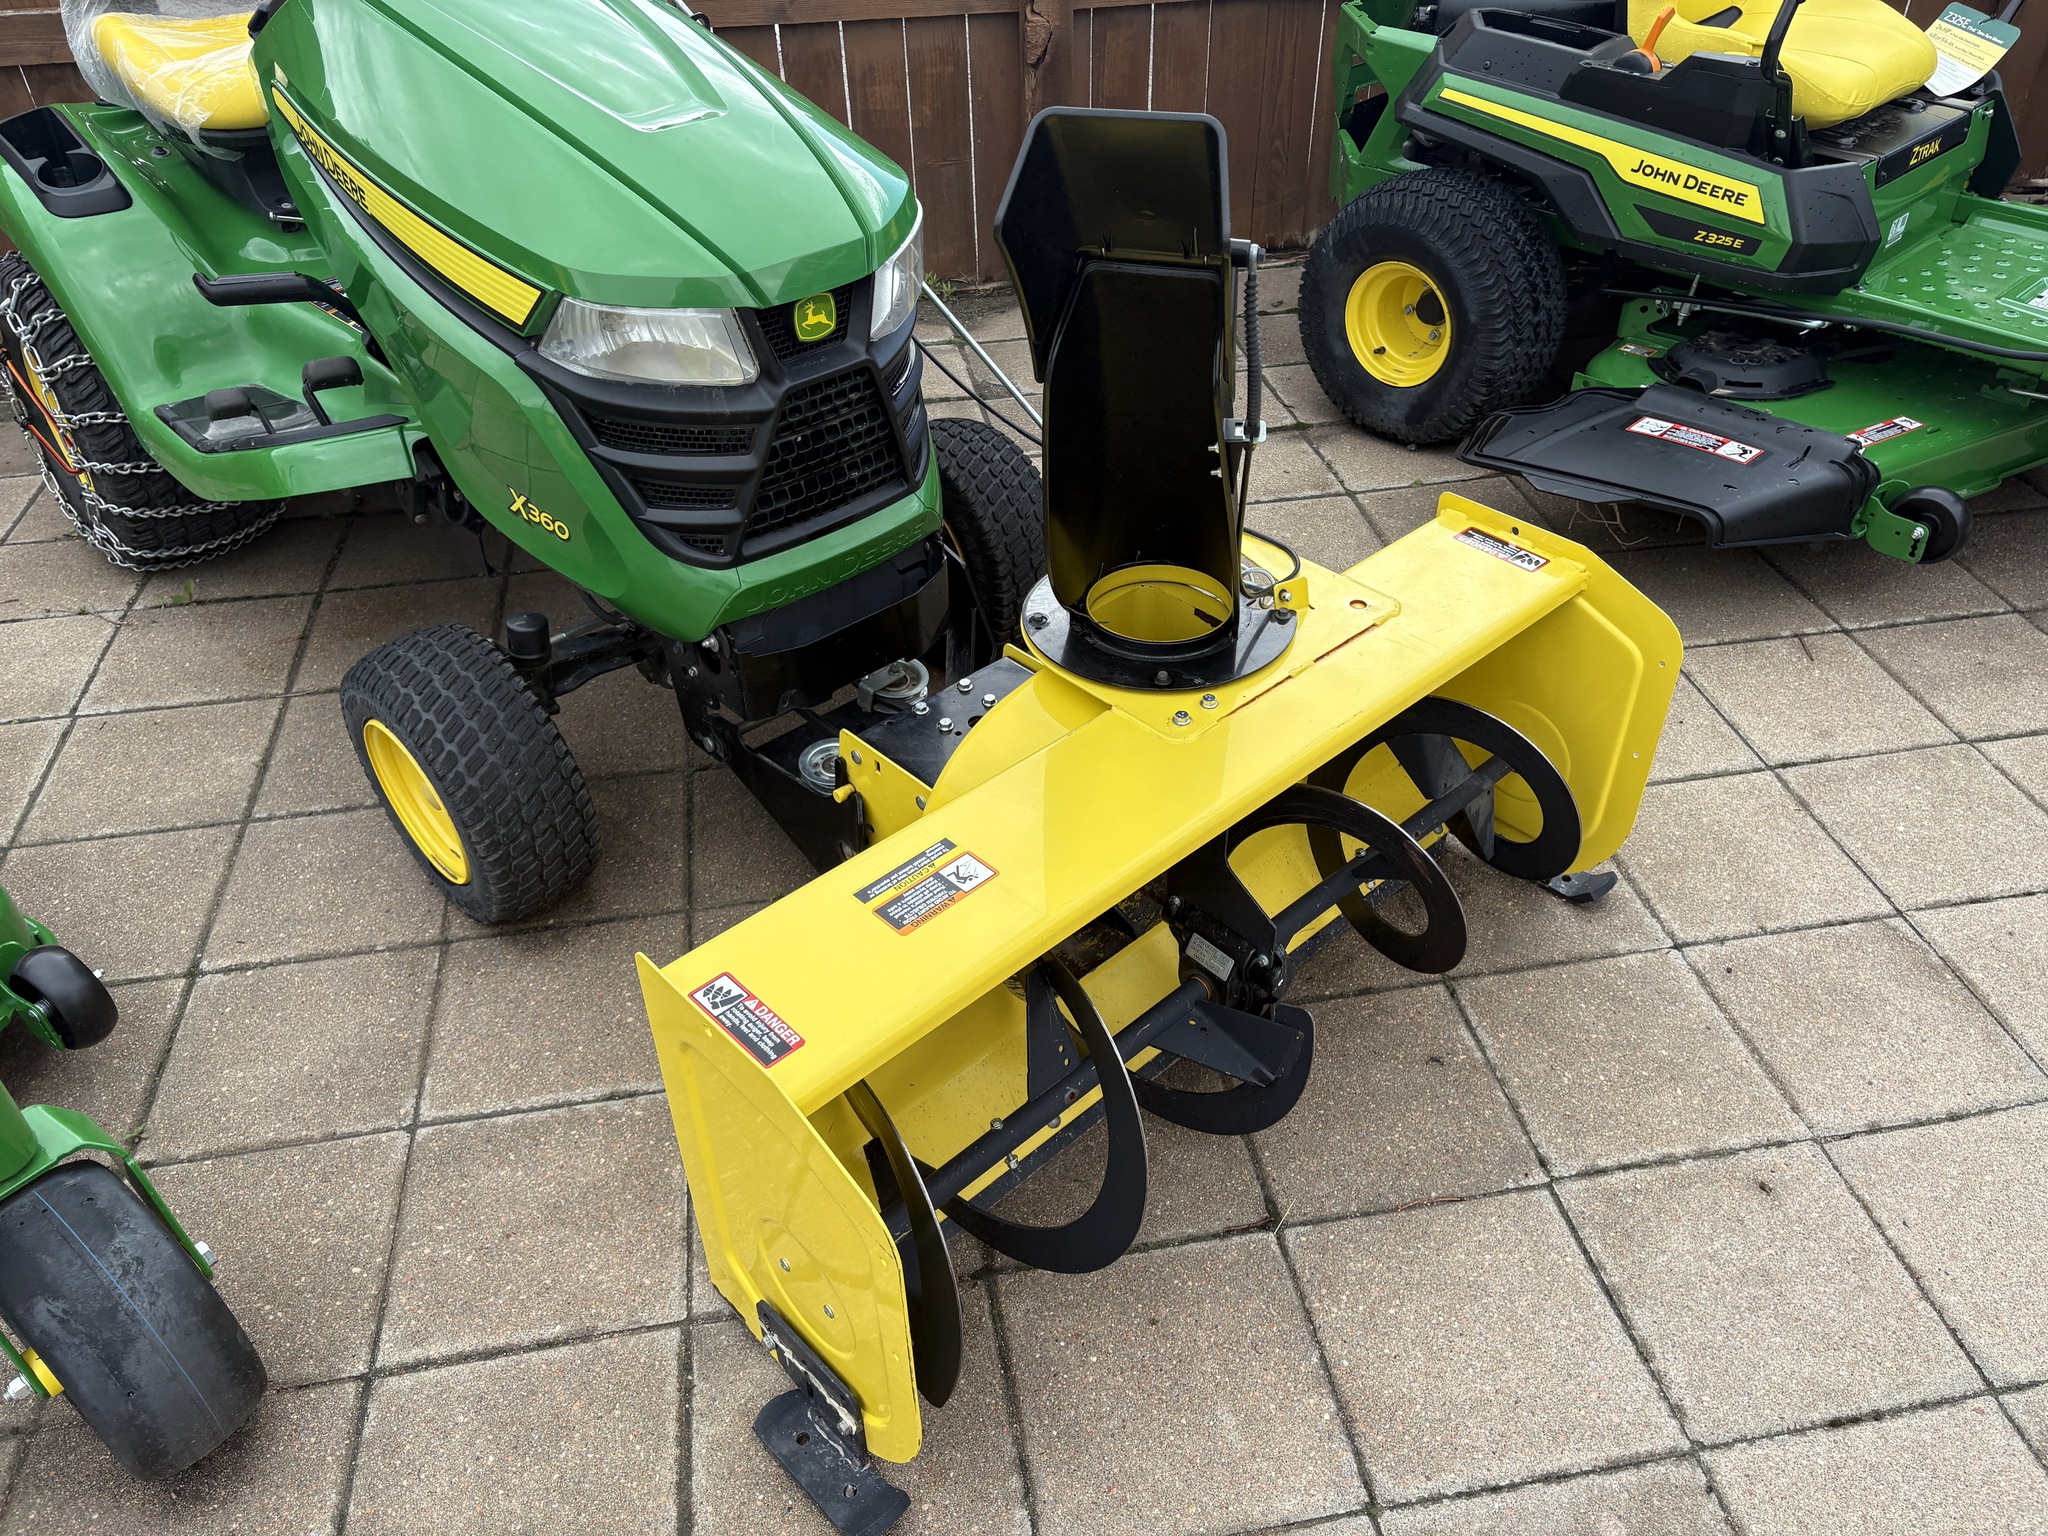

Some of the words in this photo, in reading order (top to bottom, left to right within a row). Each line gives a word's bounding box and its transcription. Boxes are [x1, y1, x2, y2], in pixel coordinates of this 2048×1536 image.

[1941, 26, 1952, 34] HP
[1943, 10, 1972, 29] Z325E
[297, 114, 324, 164] JOHN
[322, 145, 369, 212] DEERE
[1910, 137, 1942, 166] ZTRAK
[1630, 159, 1682, 186] JOHN
[1682, 173, 1749, 207] DEERE
[507, 485, 571, 541] X360
[746, 568, 835, 613] JOHN
[839, 520, 926, 579] DEERE
[893, 867, 930, 892] CAUTION
[916, 902, 935, 915] INJURY
[924, 889, 947, 904] THROWN
[933, 893, 949, 904] AVOID
[901, 913, 918, 925] FROM
[903, 902, 927, 918] OBJECTS
[910, 902, 951, 928] WARNING
[716, 1014, 734, 1028] away.
[723, 1009, 743, 1026] hands,
[738, 1023, 752, 1034] feet
[747, 1031, 760, 1042] and
[755, 1039, 778, 1059] clothing
[728, 1006, 750, 1024] rotating
[745, 1022, 764, 1037] auger,
[760, 1034, 776, 1047] keep
[735, 1002, 746, 1010] To
[742, 1008, 758, 1021] avoid
[753, 1019, 771, 1034] injury
[767, 1031, 782, 1043] from
[753, 1005, 801, 1046] DANGER
